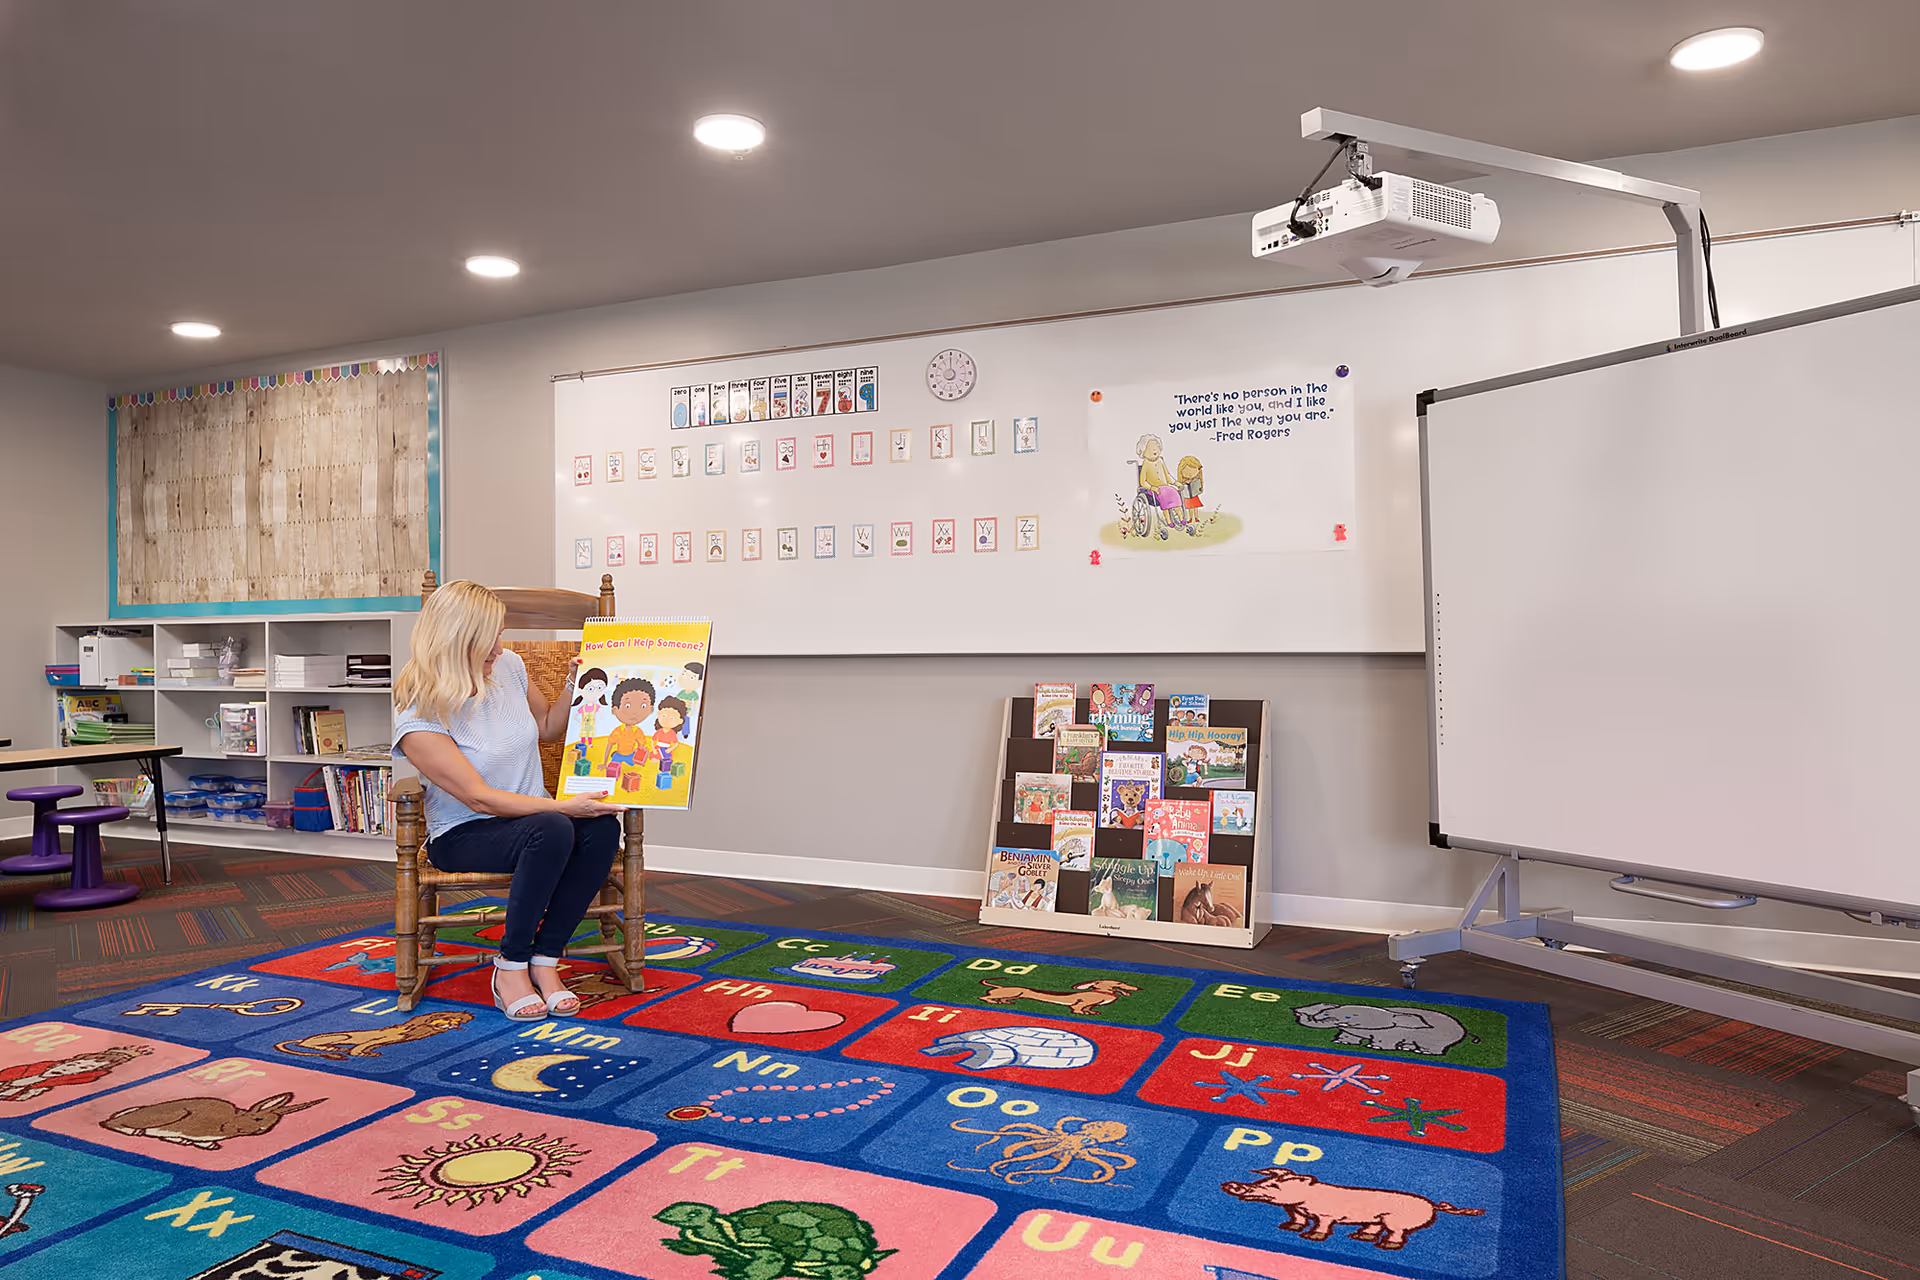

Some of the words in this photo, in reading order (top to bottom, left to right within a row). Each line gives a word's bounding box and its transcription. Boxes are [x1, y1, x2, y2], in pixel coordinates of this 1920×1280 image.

[1674, 338, 1708, 350] Interwrite
[1708, 328, 1748, 342] DualBoard
[1173, 391, 1220, 405] "There's
[1222, 391, 1239, 401] no
[1242, 387, 1288, 401] person
[1290, 384, 1302, 395] in
[1305, 382, 1328, 394] the
[1176, 404, 1213, 417] world
[1216, 403, 1235, 415] like
[1237, 401, 1265, 414] you,
[1268, 398, 1293, 409] and
[1296, 397, 1303, 408] I
[1306, 395, 1326, 407] like
[1168, 421, 1192, 433] you
[1193, 418, 1218, 432] just
[1221, 416, 1242, 427] the
[1246, 414, 1273, 426] way
[1276, 411, 1301, 426] you
[1247, 427, 1291, 440] Rogers
[778, 442, 794, 457] Gg
[856, 528, 870, 540] Vv
[937, 523, 950, 536] Xx
[978, 522, 993, 536] Yy
[1020, 519, 1036, 533] Zz
[585, 642, 604, 651] How
[606, 639, 625, 648] Can
[627, 638, 632, 647] I
[633, 637, 655, 650] Help
[656, 638, 705, 651] Someone?
[77, 699, 99, 708] ABC
[1089, 712, 1151, 729] rhyming
[1206, 731, 1245, 742] Hooray!
[1219, 745, 1244, 754] Annie
[1168, 805, 1192, 820] Baby
[1172, 817, 1206, 832] Animals
[1000, 850, 1051, 863] BENJAMIN
[1018, 865, 1048, 877] GOBLET
[1026, 862, 1052, 871] SILVER
[1178, 866, 1196, 877] Wake
[777, 938, 829, 952] Cc
[966, 958, 1038, 975] Dd
[195, 974, 259, 993] Kk
[703, 981, 773, 999] Hh
[1213, 984, 1281, 1002] Ee
[908, 1006, 956, 1023] Ii
[4, 1024, 83, 1053] Qq
[517, 1022, 621, 1050] Mm
[1189, 1044, 1258, 1067] Jj
[188, 1060, 267, 1083] Rr
[713, 1051, 800, 1078] Nn
[946, 1086, 1039, 1116] Oo
[404, 1100, 485, 1130] Ss
[1223, 1127, 1323, 1166] Pp
[668, 1146, 747, 1182] Tt
[144, 1191, 255, 1238] Xx
[1022, 1212, 1145, 1269] Uu
